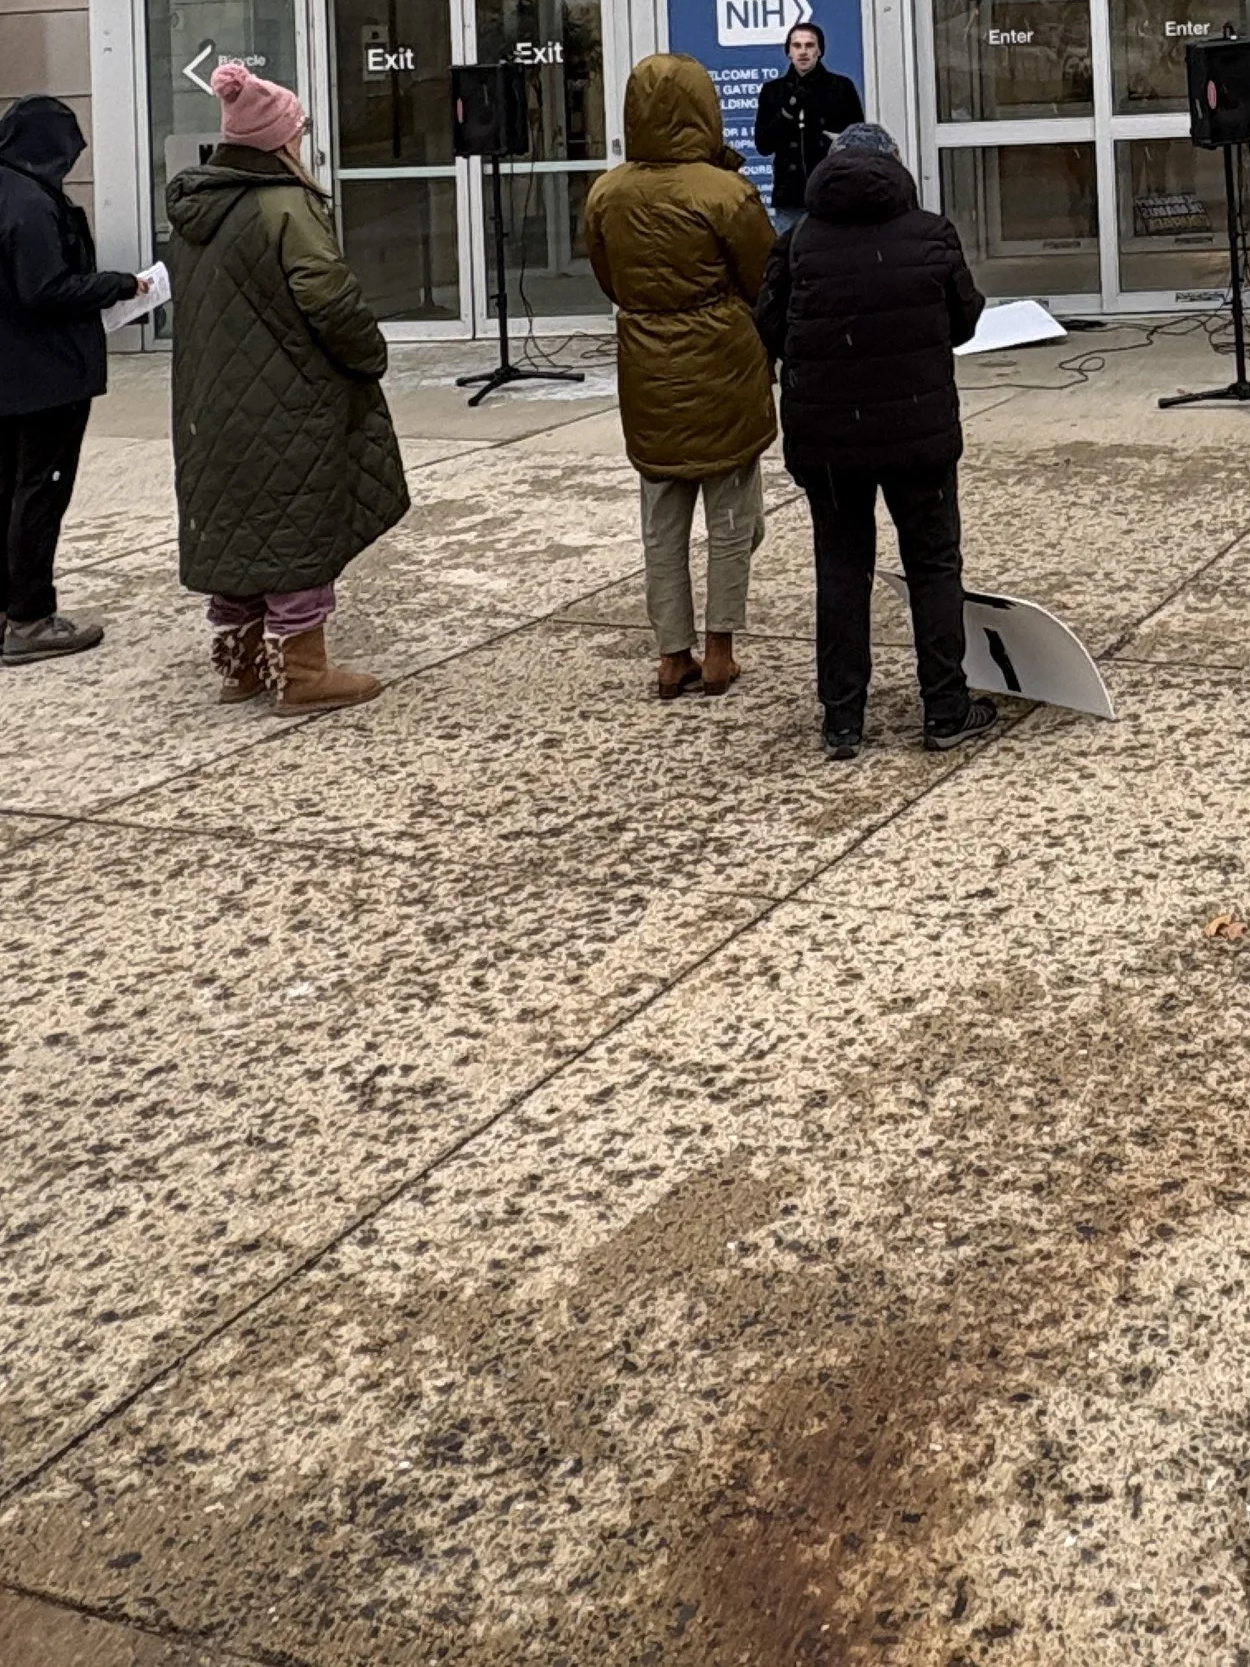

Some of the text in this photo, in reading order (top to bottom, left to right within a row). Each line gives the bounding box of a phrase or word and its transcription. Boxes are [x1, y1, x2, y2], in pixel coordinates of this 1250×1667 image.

[726, 0, 785, 29] NIH
[988, 28, 1035, 45] Enter
[1164, 20, 1211, 37] Enter
[367, 47, 415, 72] Exit
[515, 41, 564, 65] Exit
[761, 68, 779, 79] TO
